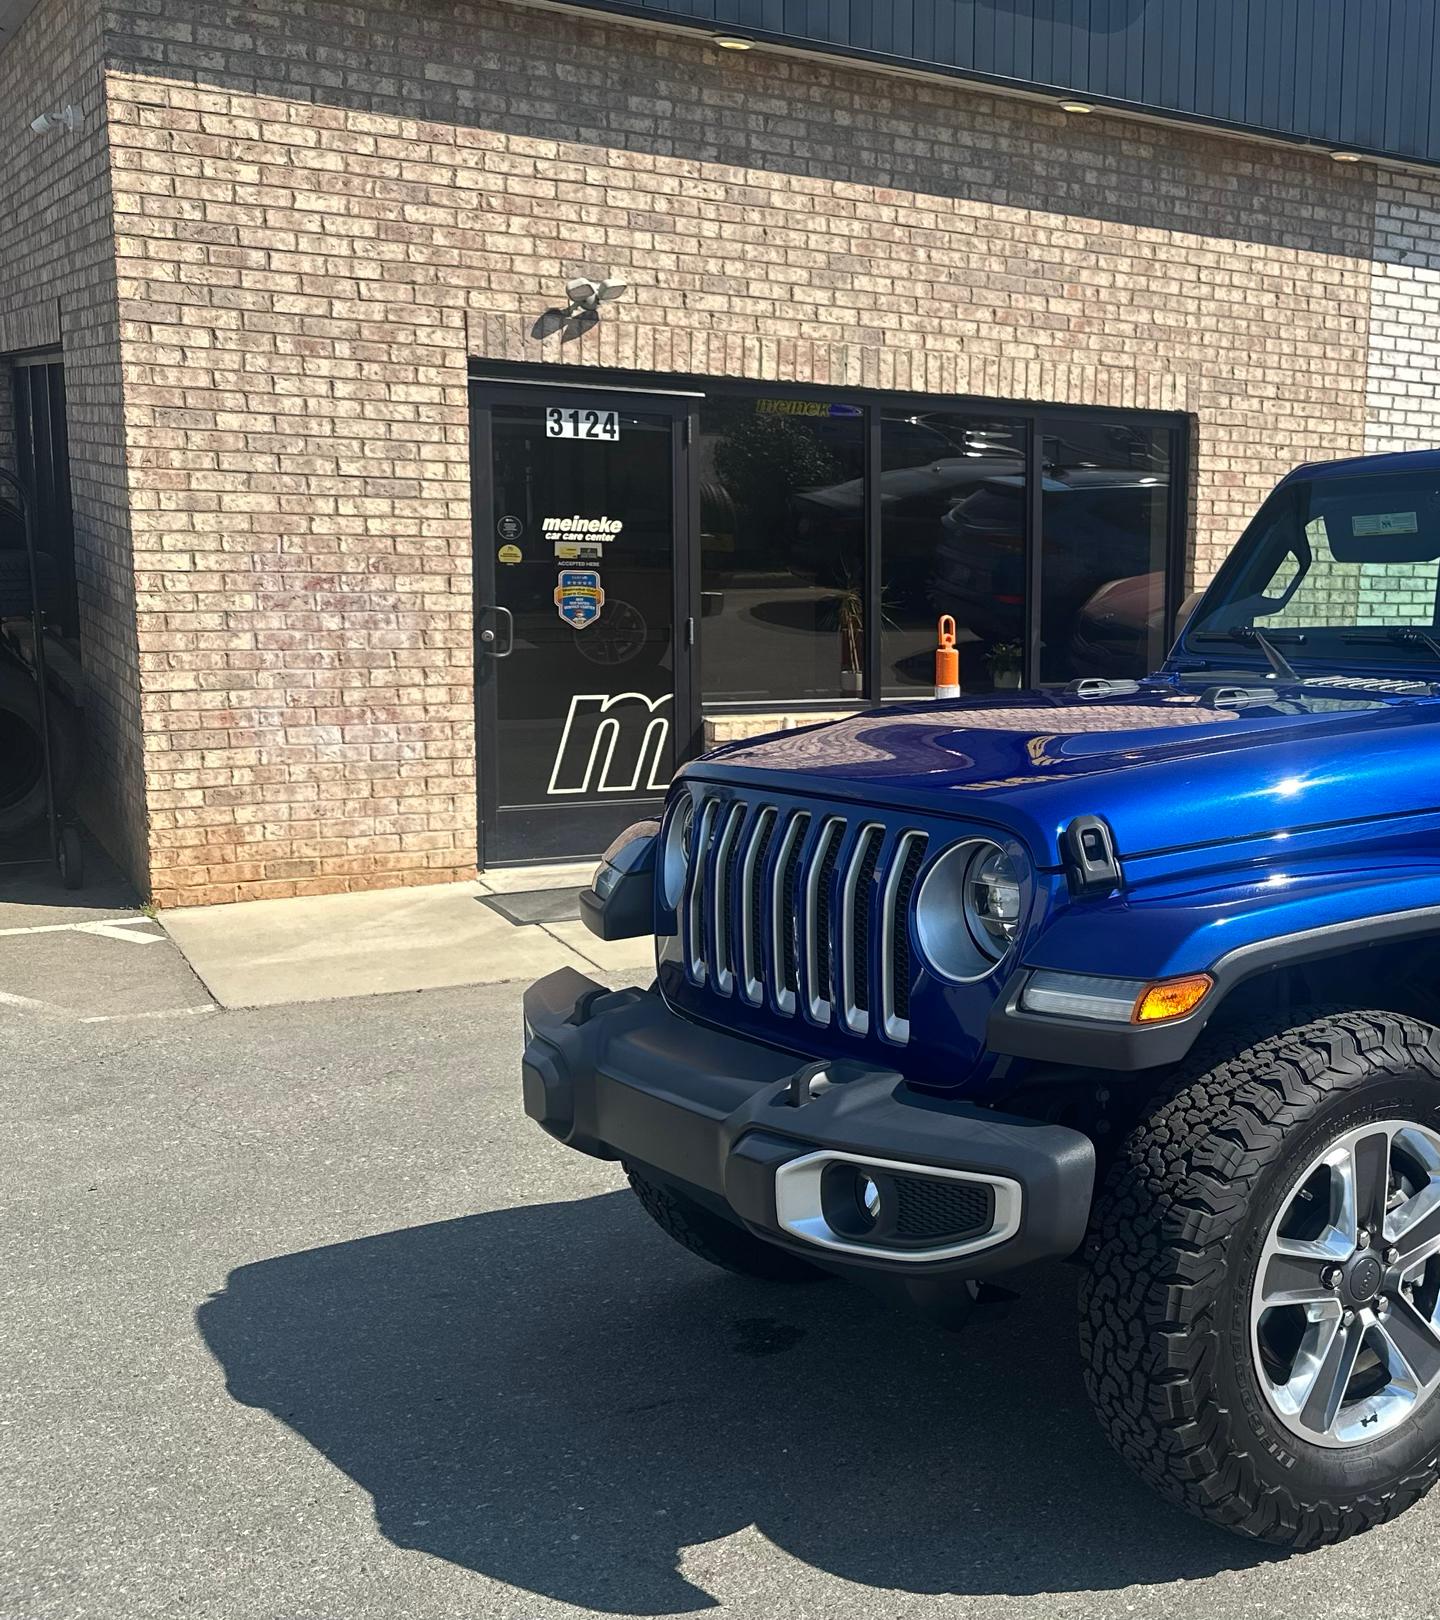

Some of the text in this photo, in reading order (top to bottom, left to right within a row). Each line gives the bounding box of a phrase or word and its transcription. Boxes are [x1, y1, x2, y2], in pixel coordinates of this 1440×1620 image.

[548, 408, 617, 439] 3124
[541, 514, 623, 534] meineke
[545, 532, 616, 542] car care center
